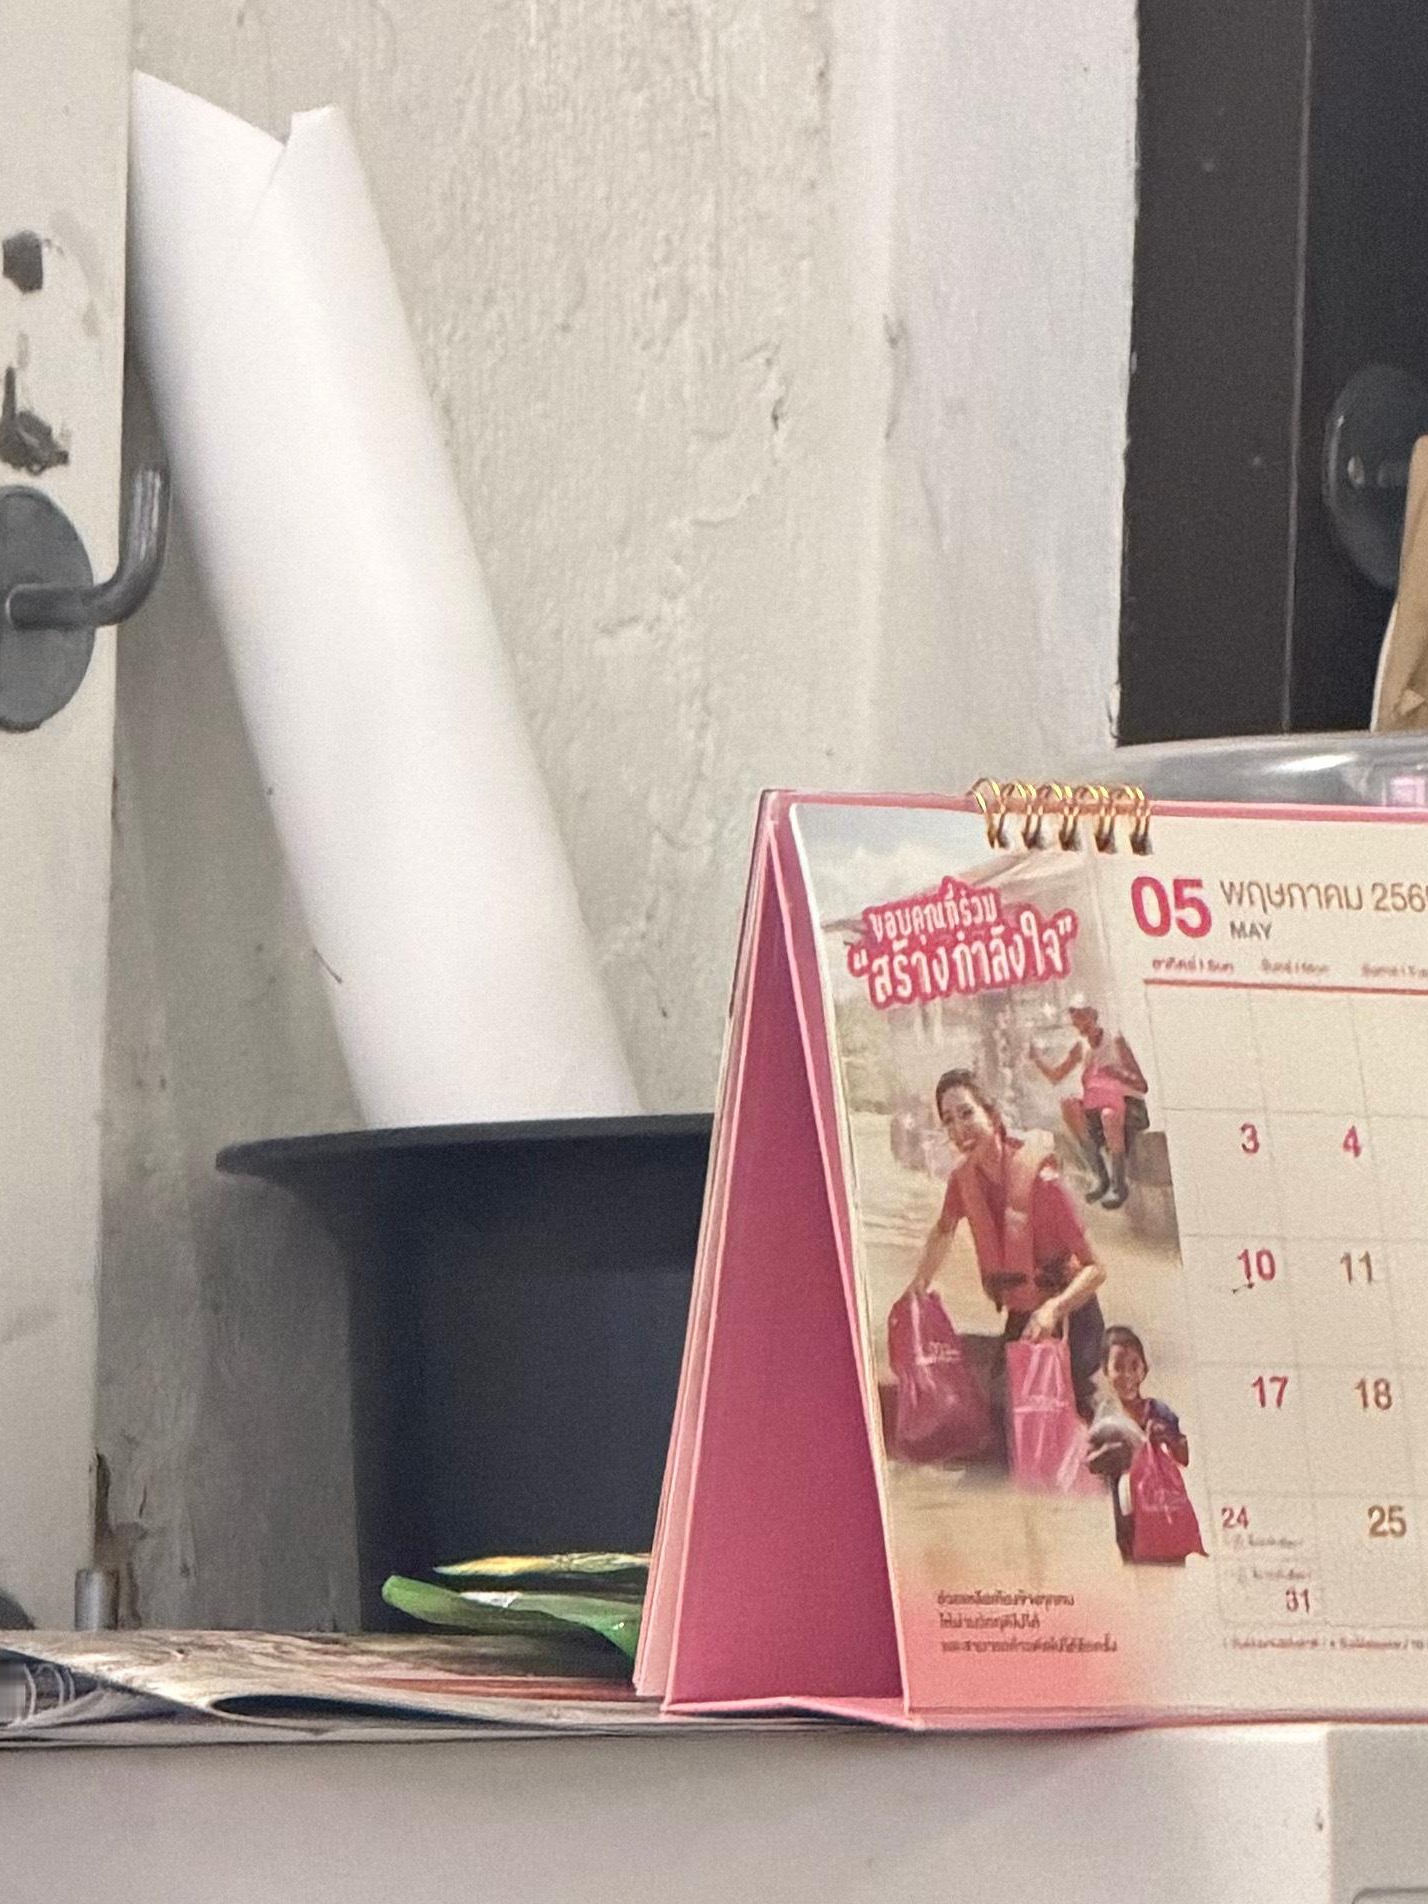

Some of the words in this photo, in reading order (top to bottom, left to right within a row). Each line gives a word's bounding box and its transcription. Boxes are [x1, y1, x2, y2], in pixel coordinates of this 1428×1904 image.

[1130, 875, 1213, 939] 05
[1219, 879, 1363, 914] พฤษภาคม
[1228, 920, 1272, 940] MAY
[1240, 1124, 1260, 1154] 3
[1343, 1126, 1361, 1157] 4
[1238, 1249, 1275, 1281] 10
[1340, 1252, 1373, 1284] 11
[1252, 1376, 1288, 1408] 17
[1356, 1378, 1392, 1410] 18
[1222, 1506, 1249, 1528] 24
[1368, 1505, 1406, 1537] 25
[1285, 1586, 1310, 1613] 31
